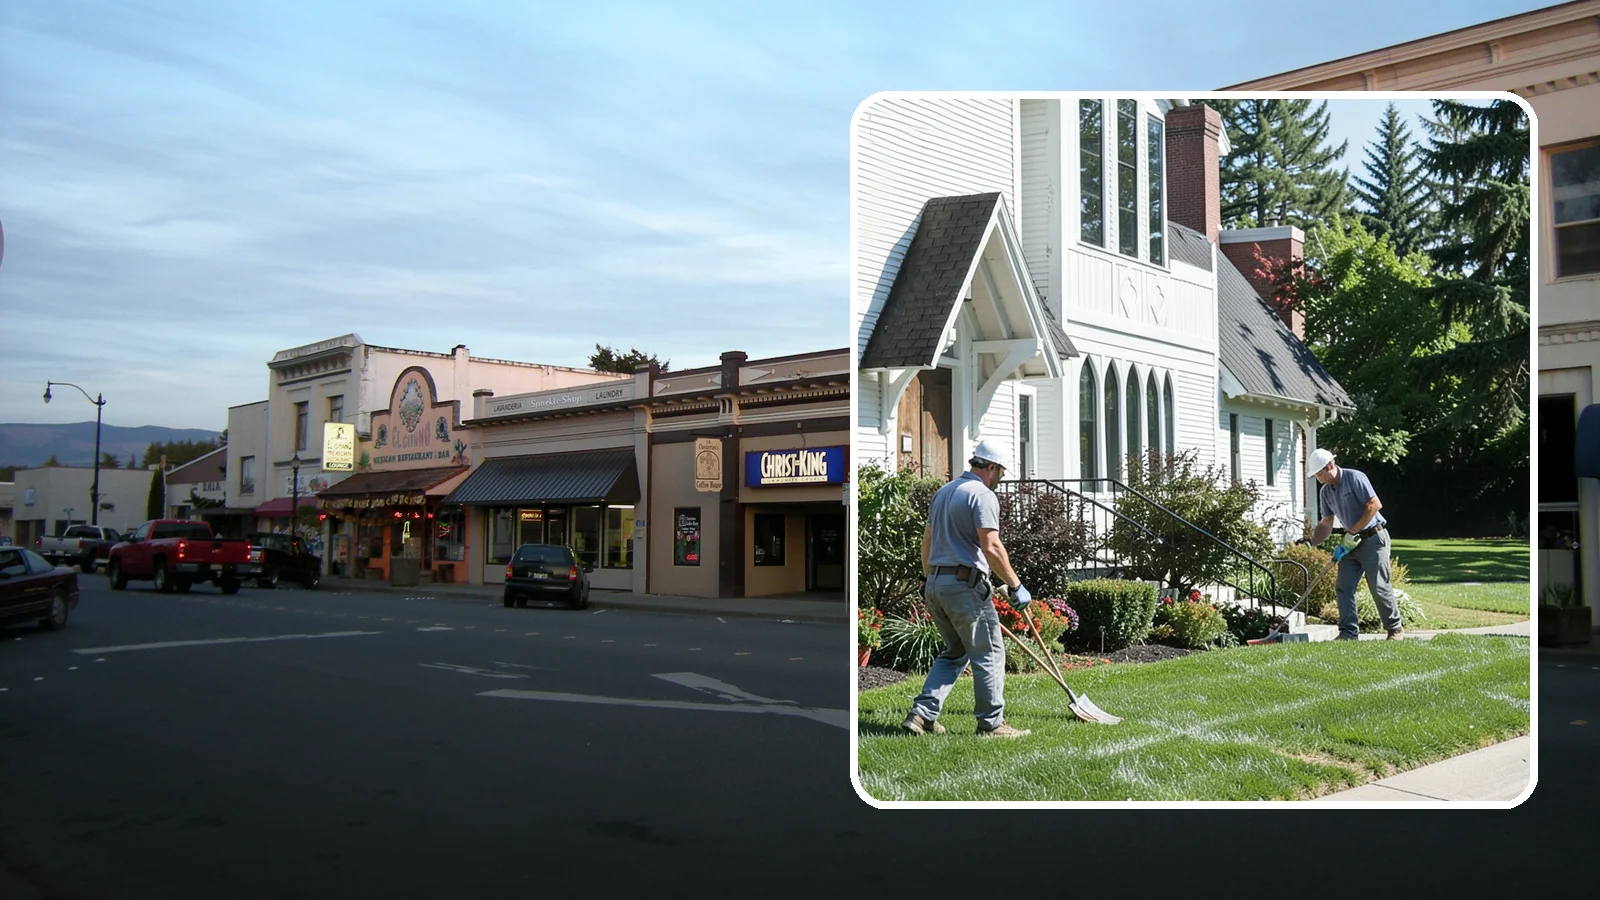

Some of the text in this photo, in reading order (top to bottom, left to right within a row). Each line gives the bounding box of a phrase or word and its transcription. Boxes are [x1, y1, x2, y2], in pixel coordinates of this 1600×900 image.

[493, 389, 624, 413] LAVANDERIA Sparkle Shop LAUNDRY
[373, 450, 450, 464] MEXICAN RESTAURANT BAR
[760, 450, 828, 478] CHRIST KING
